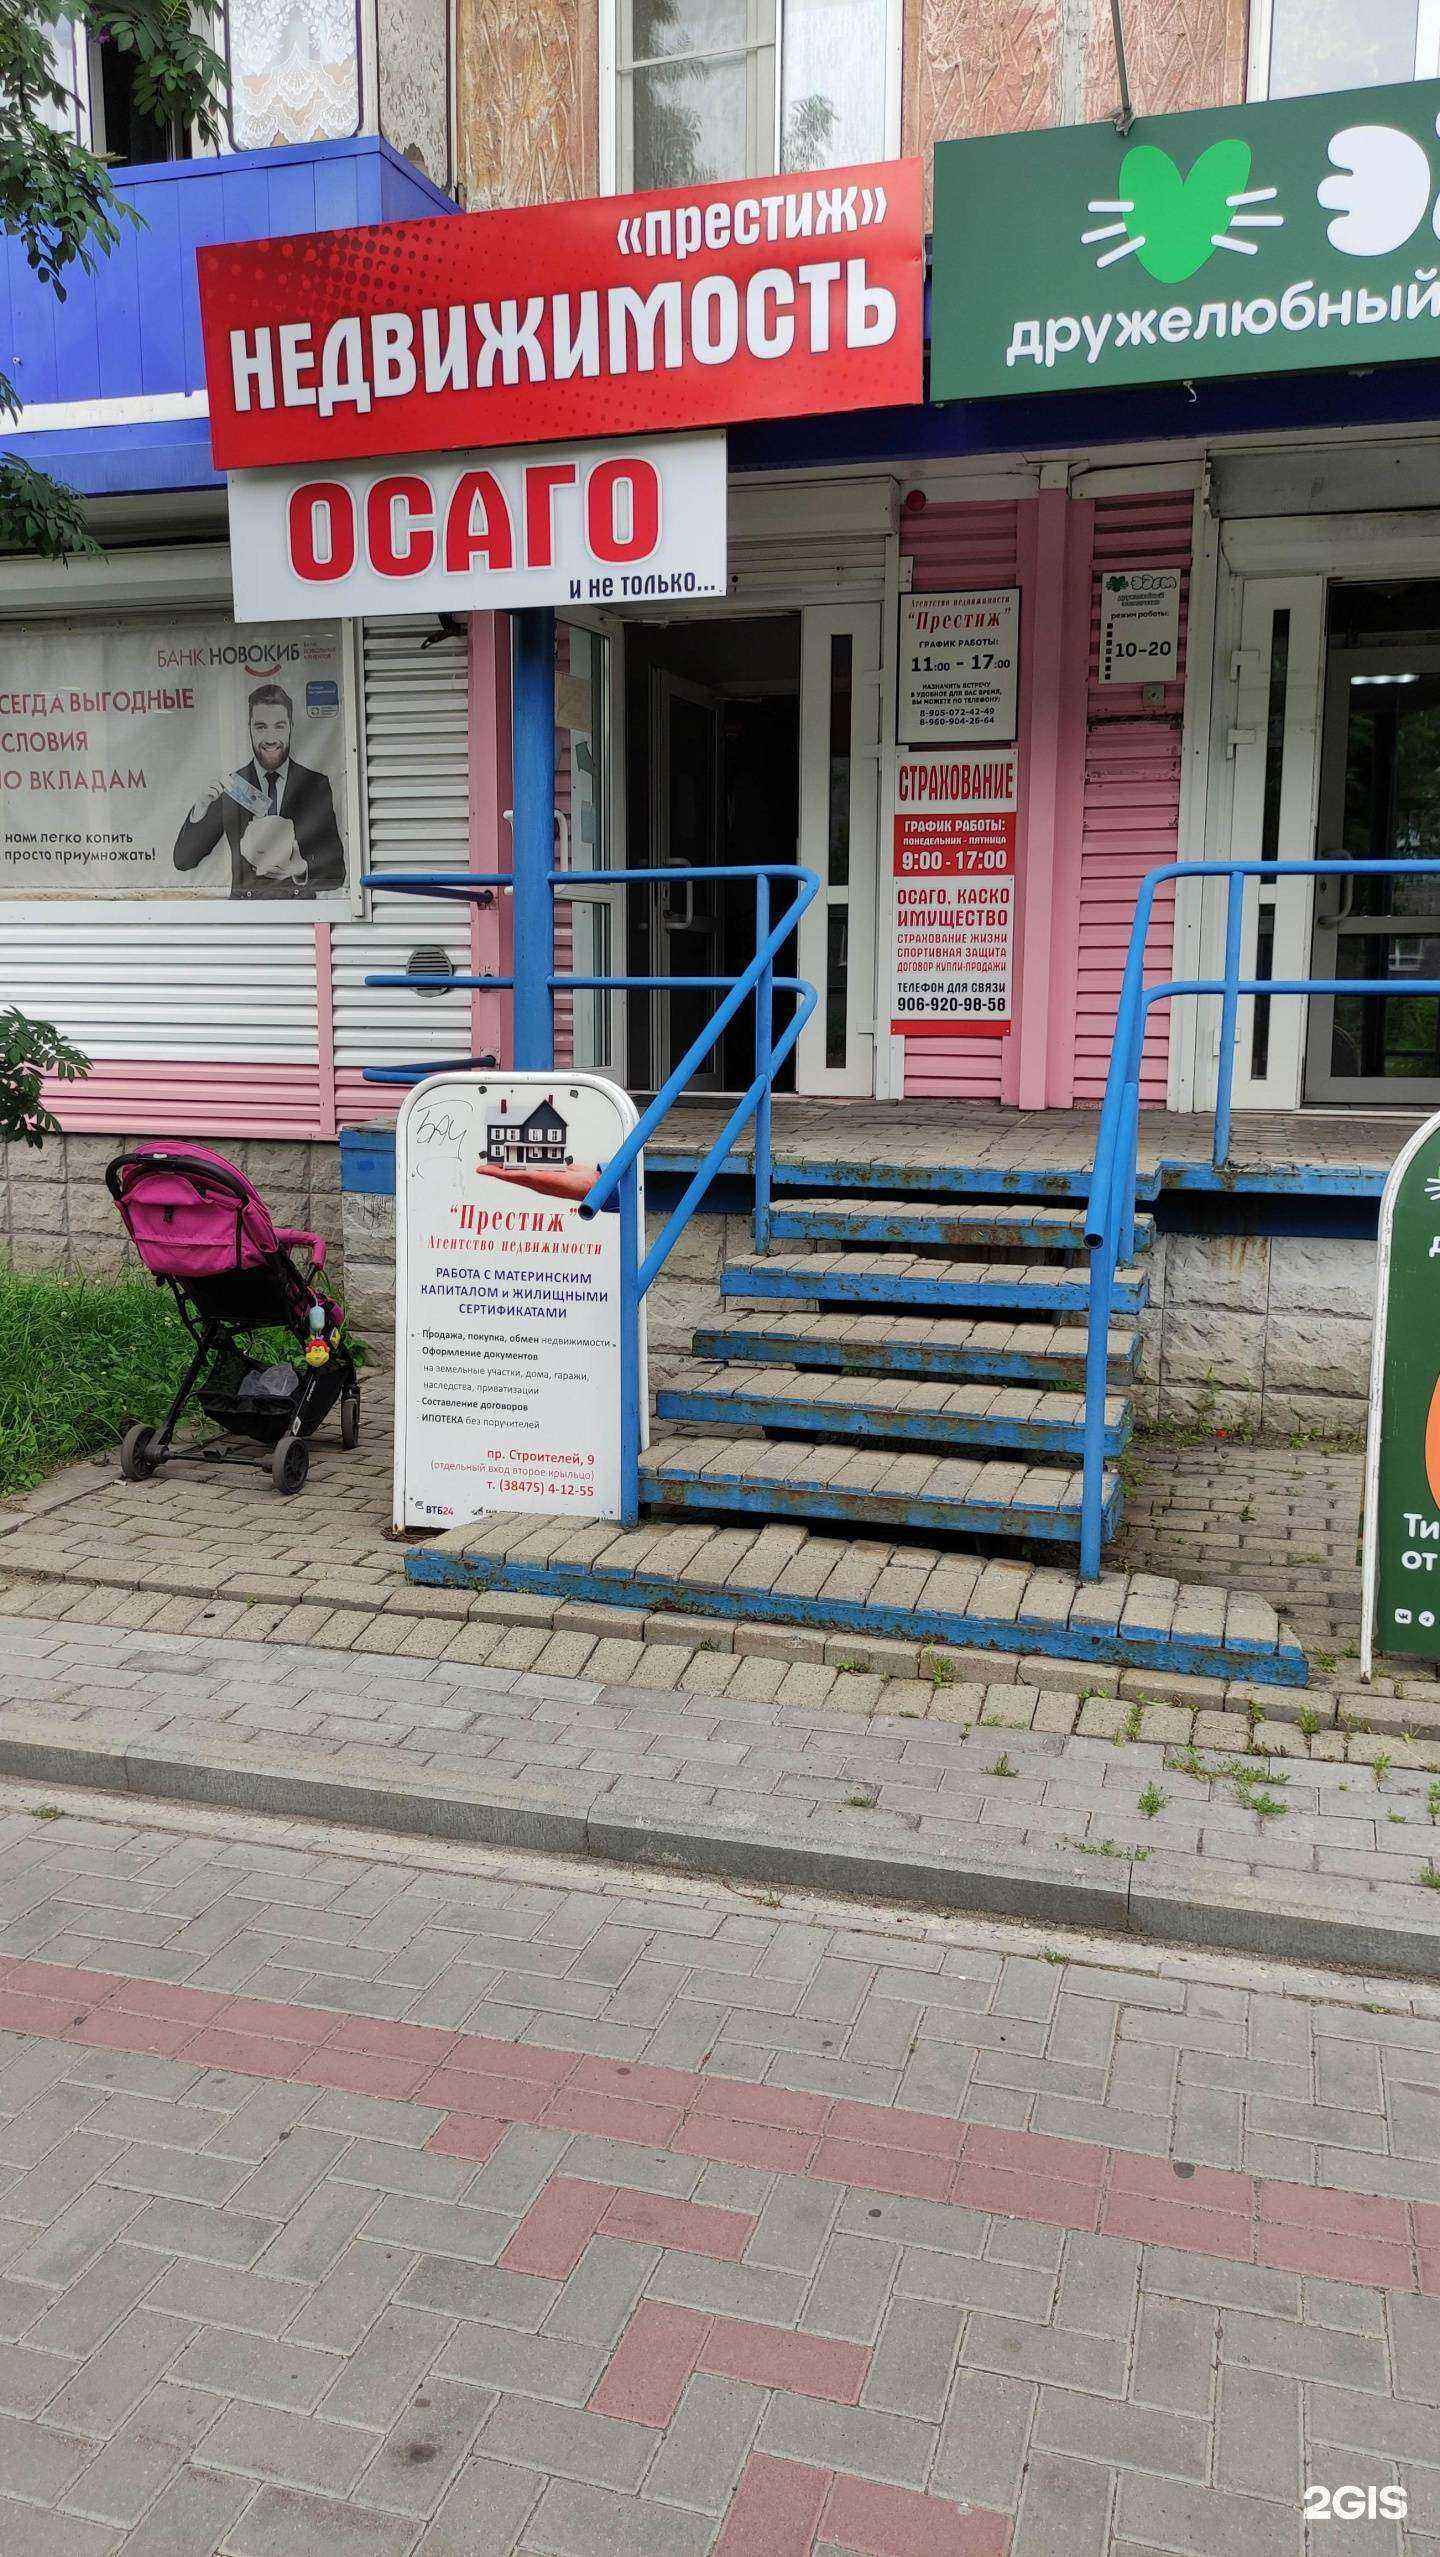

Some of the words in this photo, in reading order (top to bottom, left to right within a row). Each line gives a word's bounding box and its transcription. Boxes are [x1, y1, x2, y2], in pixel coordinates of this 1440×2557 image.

[1007, 267, 1440, 367] дружелюбный
[230, 258, 897, 417] НЕДВИЖИМОСТЬ
[287, 457, 664, 582] ОСАГО
[570, 579, 580, 598] и
[589, 578, 613, 597] не
[621, 572, 715, 595] только...
[909, 607, 1010, 633] “Престиж”
[158, 648, 206, 667] БАНК
[210, 644, 299, 665] НОВОКИБ
[1116, 641, 1171, 657] 10-20
[912, 656, 950, 671] 11:00
[972, 654, 1010, 669] 17:00
[71, 688, 194, 714] ВЫГОДНЫЕ
[31, 769, 147, 792] ВКЛАДАМ
[900, 763, 1013, 801] СТРАХОВАНИЕ
[905, 820, 951, 832] ГРАФИК
[956, 819, 1005, 831] РАБОТЫ:
[5, 833, 37, 843] нами
[41, 833, 81, 843] легко
[86, 833, 133, 843] копить
[969, 836, 1006, 844] ПЯТНИЦА
[5, 850, 51, 863] просто
[56, 848, 155, 865] приумножать!
[903, 852, 942, 870] 9:00
[956, 850, 1006, 869] 17:00
[898, 889, 951, 905] ОСАГО,
[957, 889, 1009, 903] КАСКО
[898, 910, 1007, 928] ИМУЩЕСТВО
[898, 934, 967, 943] СТРАХОВАНИЕ
[971, 934, 1007, 943] ЖИЗНИ
[898, 948, 961, 957] СПОРТИВНАЯ
[966, 948, 1006, 958] ЗАЩИТА
[898, 963, 933, 973] ДОГОВОР
[937, 962, 1006, 973] КУПЛИ-ПРОДАЖИ
[898, 983, 943, 992] ТЕЛЕФОН
[947, 983, 967, 993] ДЛЯ
[972, 983, 1005, 992] СВЯЗИ
[450, 1205, 579, 1235] “Престиж”
[428, 1236, 494, 1251] Агентство
[502, 1240, 602, 1256] недвижимости
[436, 1268, 480, 1280] РАБОТА
[484, 1270, 490, 1280] С
[494, 1270, 592, 1283] МАТЕРИНСКИМ
[421, 1285, 498, 1297] КАПИТАЛОМ
[513, 1288, 608, 1302] ЖИЛИЩНЫМИ
[459, 1304, 567, 1318] СЕРТИФИКАТАМИ
[422, 1329, 464, 1341] Продажа,
[468, 1334, 507, 1343] покупка,
[510, 1334, 539, 1344] обмен
[541, 1337, 610, 1347] недвижимости
[422, 1347, 481, 1359] Оформление
[484, 1352, 538, 1360] документов
[435, 1366, 485, 1375] земельные
[487, 1369, 523, 1378] участки,
[526, 1371, 552, 1380] дома,
[555, 1373, 589, 1382] гаражи,
[424, 1382, 475, 1393] наследства,
[477, 1385, 539, 1395] приватизации
[422, 1398, 478, 1408] Составление
[481, 1401, 528, 1411] договоров
[422, 1415, 463, 1424] ИПОТЕКА
[466, 1416, 481, 1425] без
[484, 1419, 539, 1429] поручителей
[487, 1450, 505, 1461] пр.
[510, 1450, 584, 1465] Строителей,
[588, 1455, 594, 1465] 9
[431, 1461, 485, 1472] (отдельный
[489, 1466, 510, 1475] вход
[513, 1468, 546, 1476] второе
[548, 1470, 594, 1481] крыльцо)
[500, 1480, 544, 1495] (38475)
[548, 1484, 594, 1496] 4-12-55
[426, 1506, 454, 1516] ВТБ24
[1401, 1551, 1438, 1571] от
